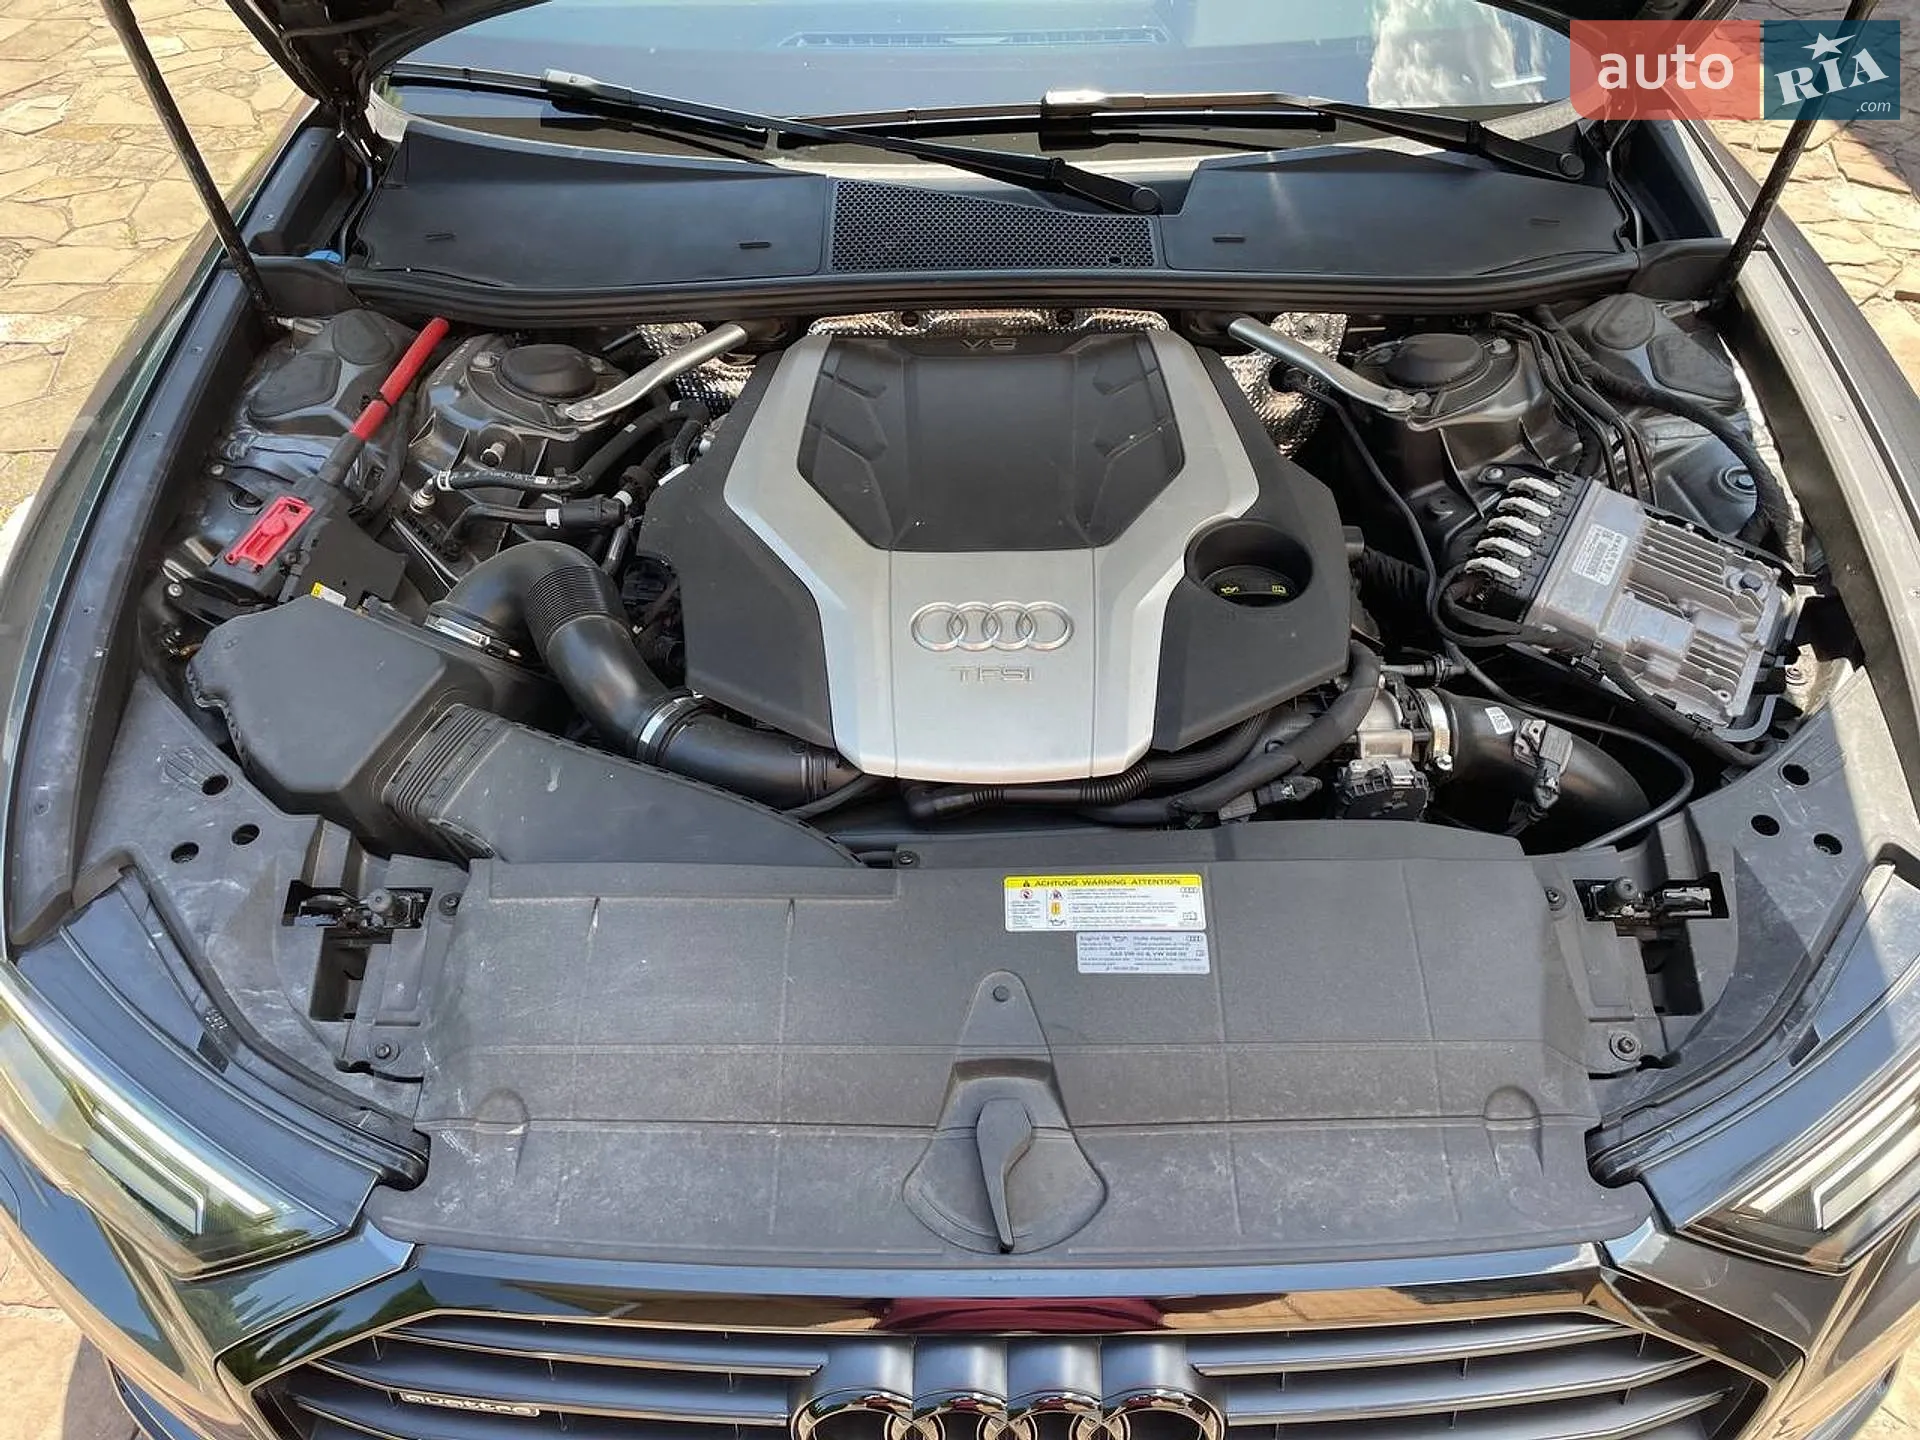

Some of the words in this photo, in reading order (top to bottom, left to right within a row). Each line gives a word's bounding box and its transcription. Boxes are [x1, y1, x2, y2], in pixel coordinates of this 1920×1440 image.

[961, 337, 1018, 351] V6
[949, 664, 1032, 681] TFSI
[1034, 879, 1079, 887] ACHTUNG
